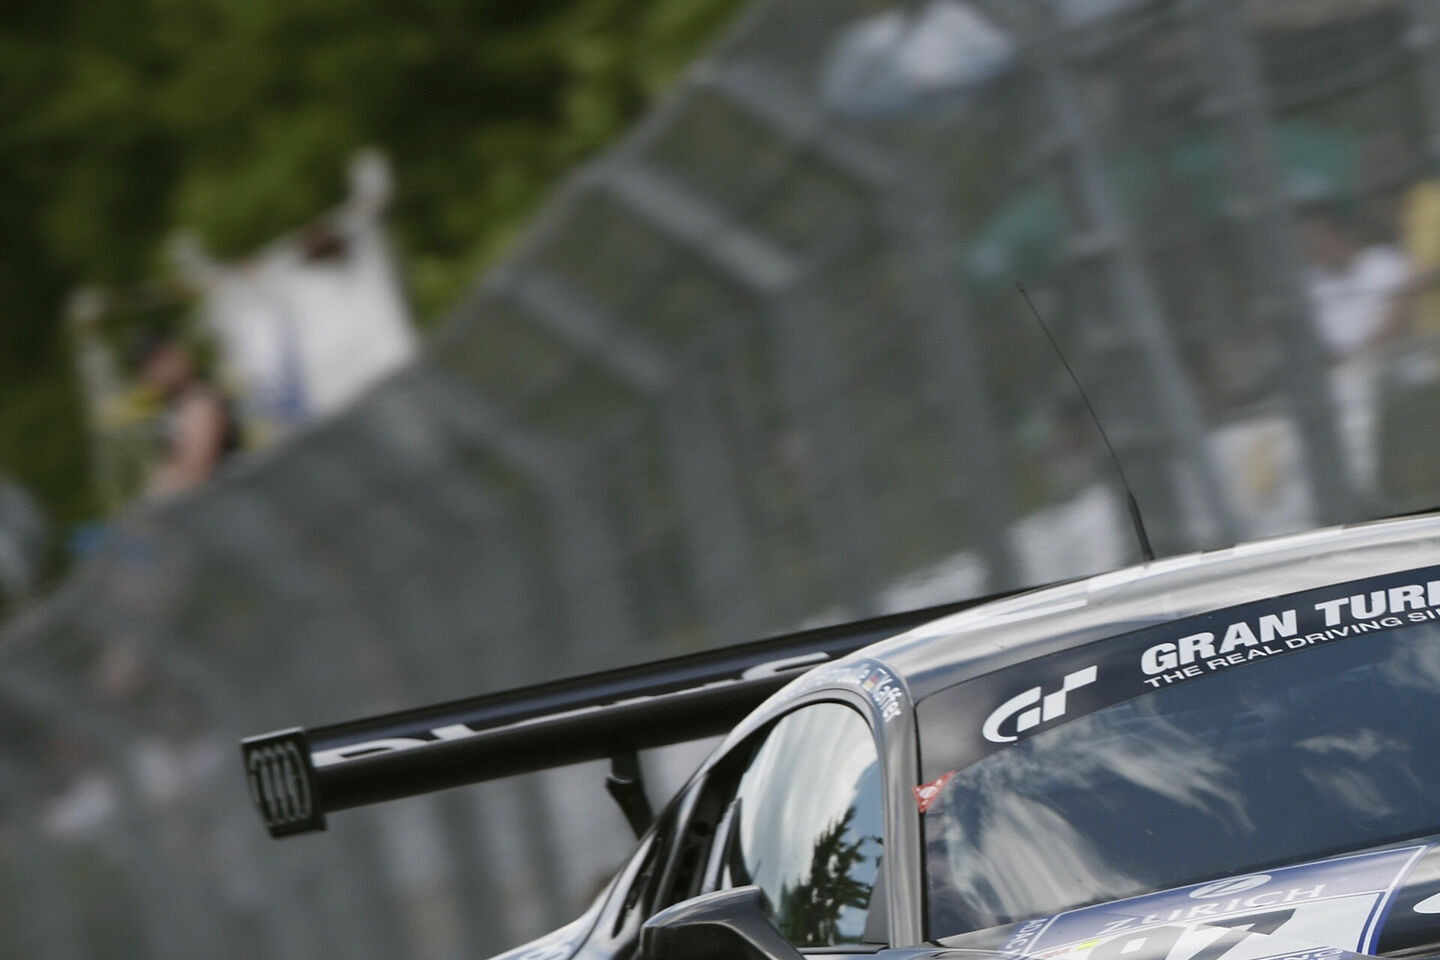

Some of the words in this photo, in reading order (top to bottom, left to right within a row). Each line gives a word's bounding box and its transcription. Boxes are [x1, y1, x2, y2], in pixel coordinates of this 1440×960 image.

[1140, 608, 1298, 677] GRAN
[1143, 664, 1204, 689] THE
[1207, 646, 1284, 672] REAL
[1284, 616, 1404, 650] DRIVING
[1096, 883, 1327, 936] ZURICH
